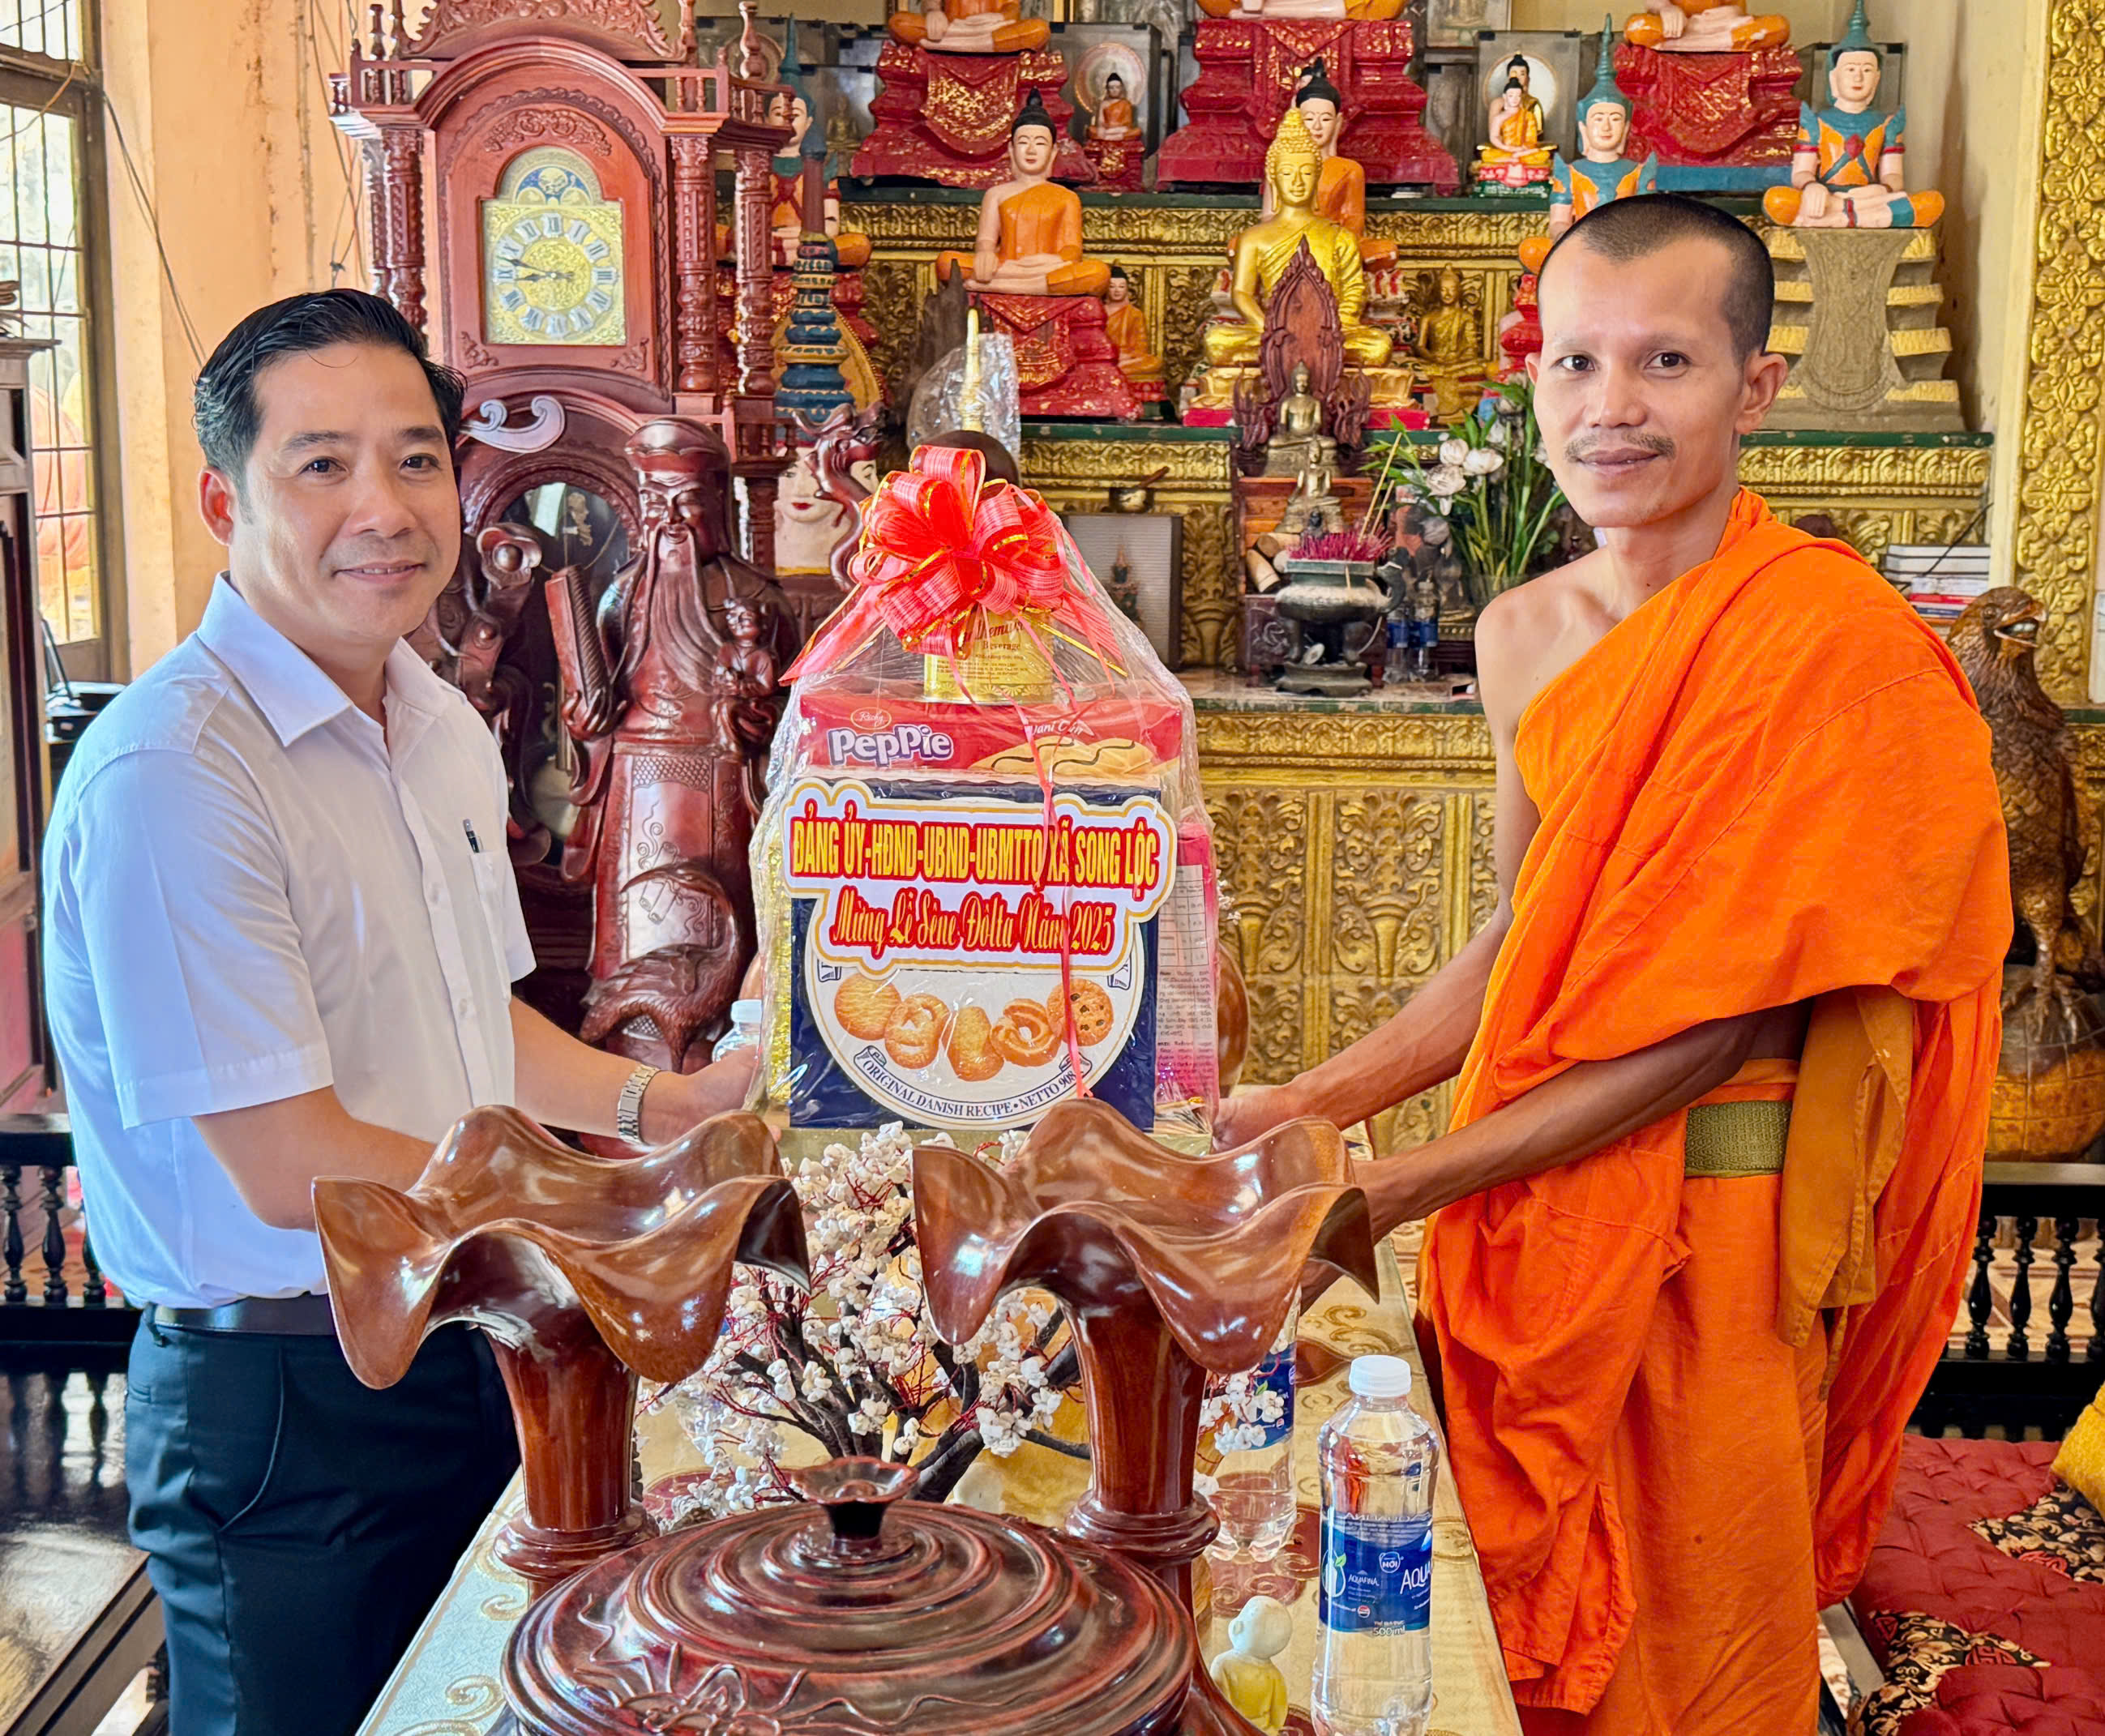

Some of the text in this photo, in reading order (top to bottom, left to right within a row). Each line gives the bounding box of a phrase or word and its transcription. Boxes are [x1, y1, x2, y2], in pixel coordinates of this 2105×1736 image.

[792, 801, 841, 875] ĐẢNG
[1074, 829, 1122, 885] SONG
[1123, 820, 1157, 898] LỘC
[832, 887, 886, 956] Mừng
[1069, 904, 1114, 952] 2025
[862, 1058, 915, 1104] ORIGINAL
[916, 1094, 964, 1116] DANISH
[965, 1101, 1013, 1117] RECIPE
[1018, 1083, 1060, 1110] NETTO
[1373, 1627, 1393, 1636] 500
